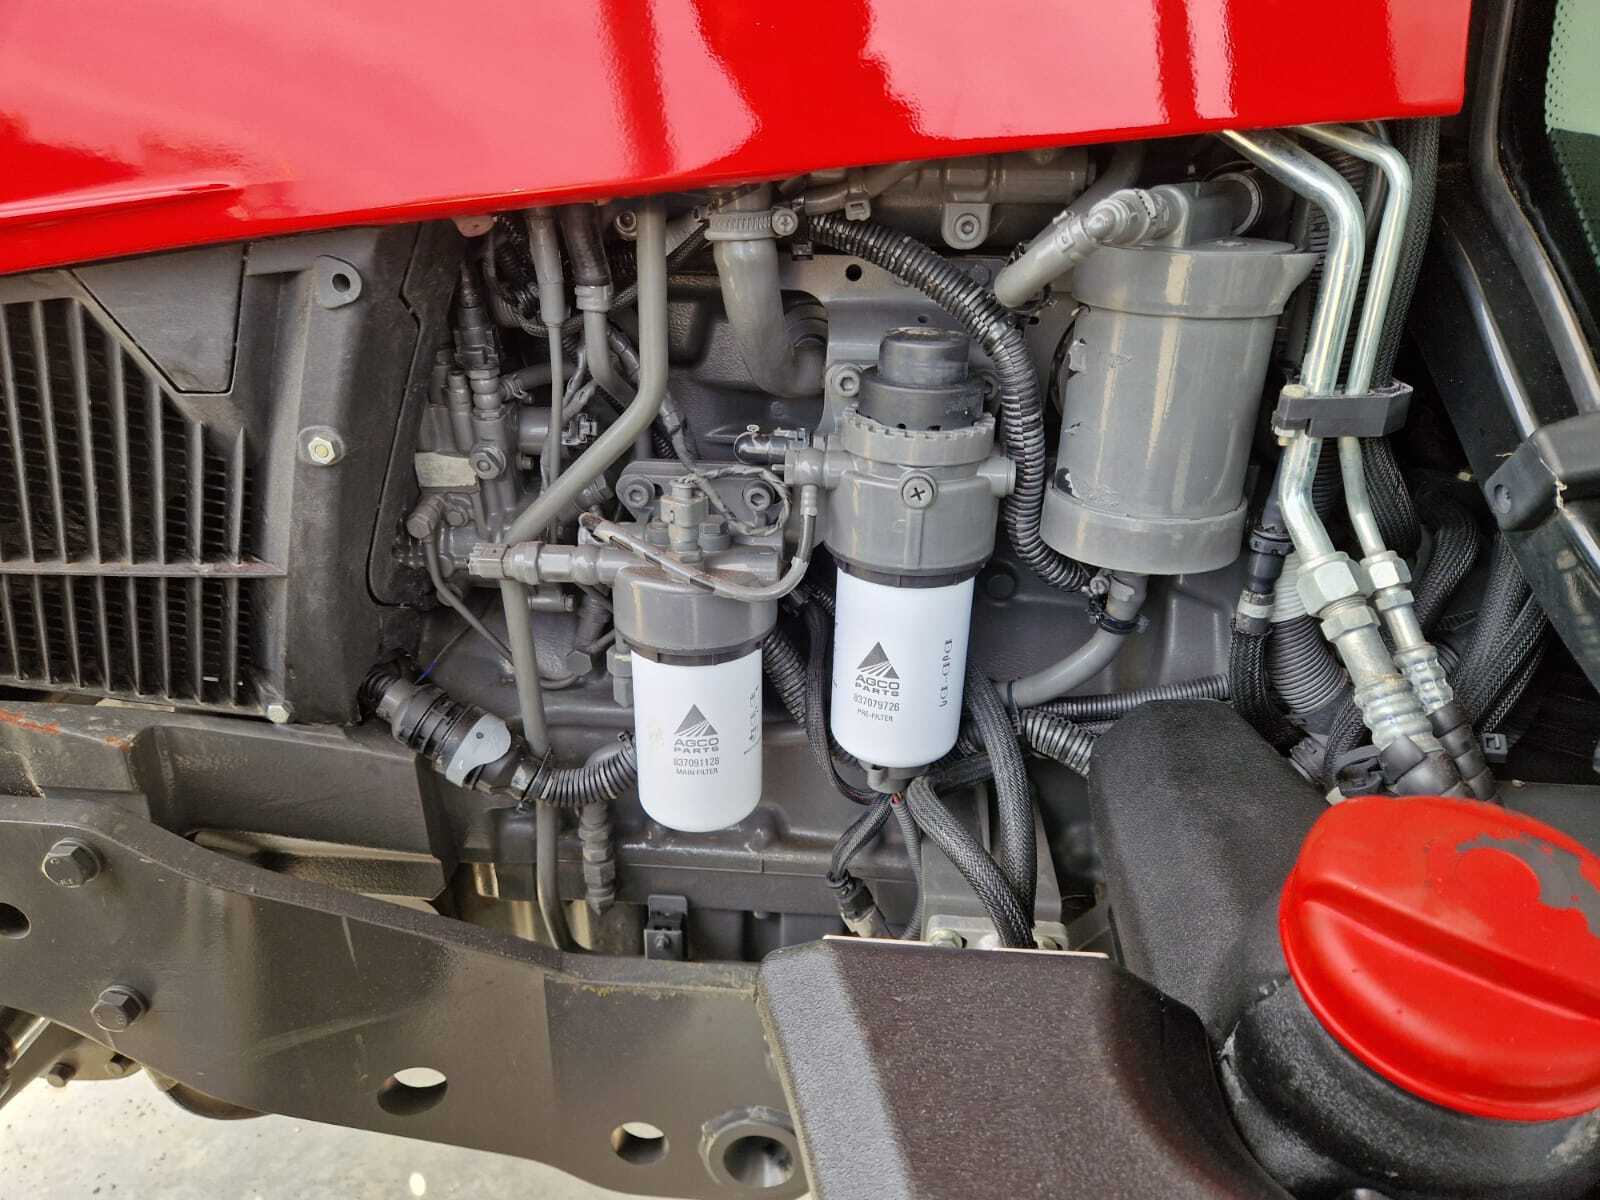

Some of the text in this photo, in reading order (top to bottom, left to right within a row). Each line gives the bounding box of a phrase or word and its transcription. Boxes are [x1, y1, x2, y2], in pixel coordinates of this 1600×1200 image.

[855, 674, 900, 690] AGCO
[854, 682, 900, 697] PARTS
[857, 708, 894, 722] PRE-FILTER
[674, 738, 720, 747] AGCO
[674, 746, 720, 754] PARTS
[676, 767, 719, 776] MAIN FILTER
